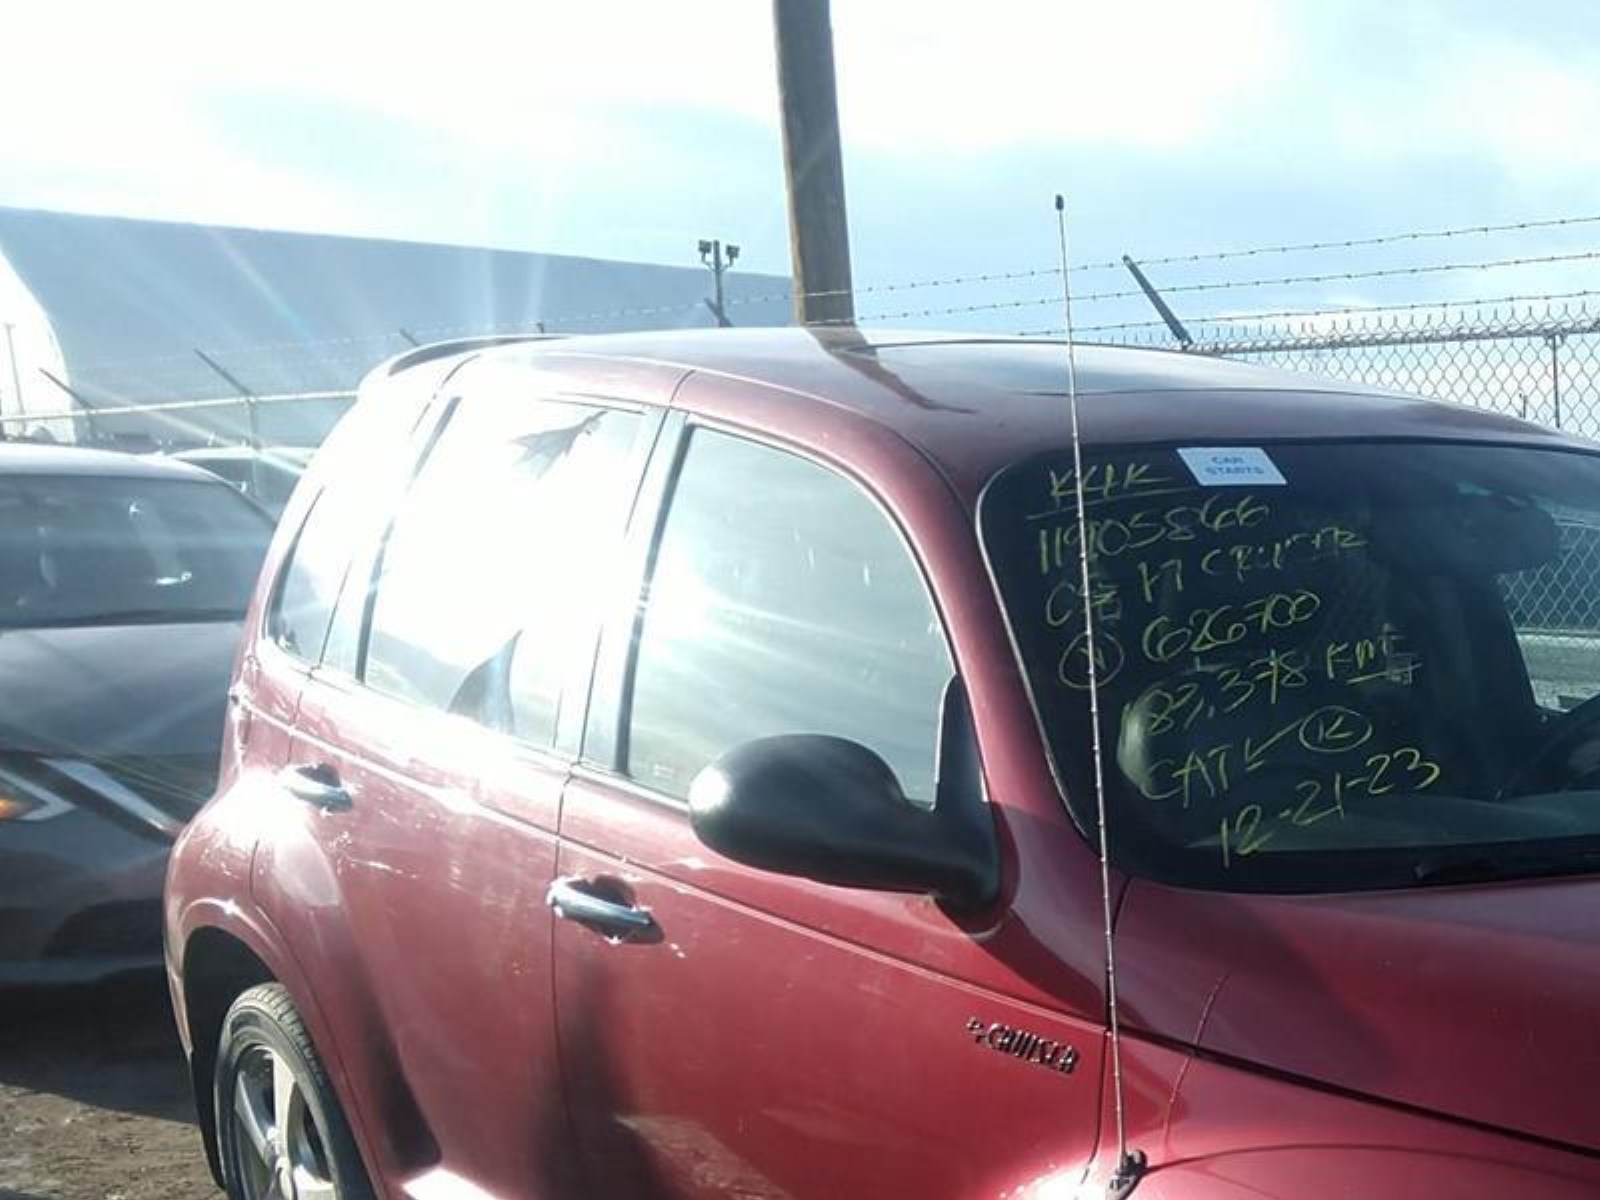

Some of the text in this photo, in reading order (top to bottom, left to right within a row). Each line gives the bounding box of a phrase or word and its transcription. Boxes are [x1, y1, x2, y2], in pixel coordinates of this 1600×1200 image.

[1041, 493, 1270, 575] 11905866
[1141, 590, 1322, 662] 626700
[1142, 744, 1234, 809] CAT
[1219, 747, 1441, 869] 12-21-23
